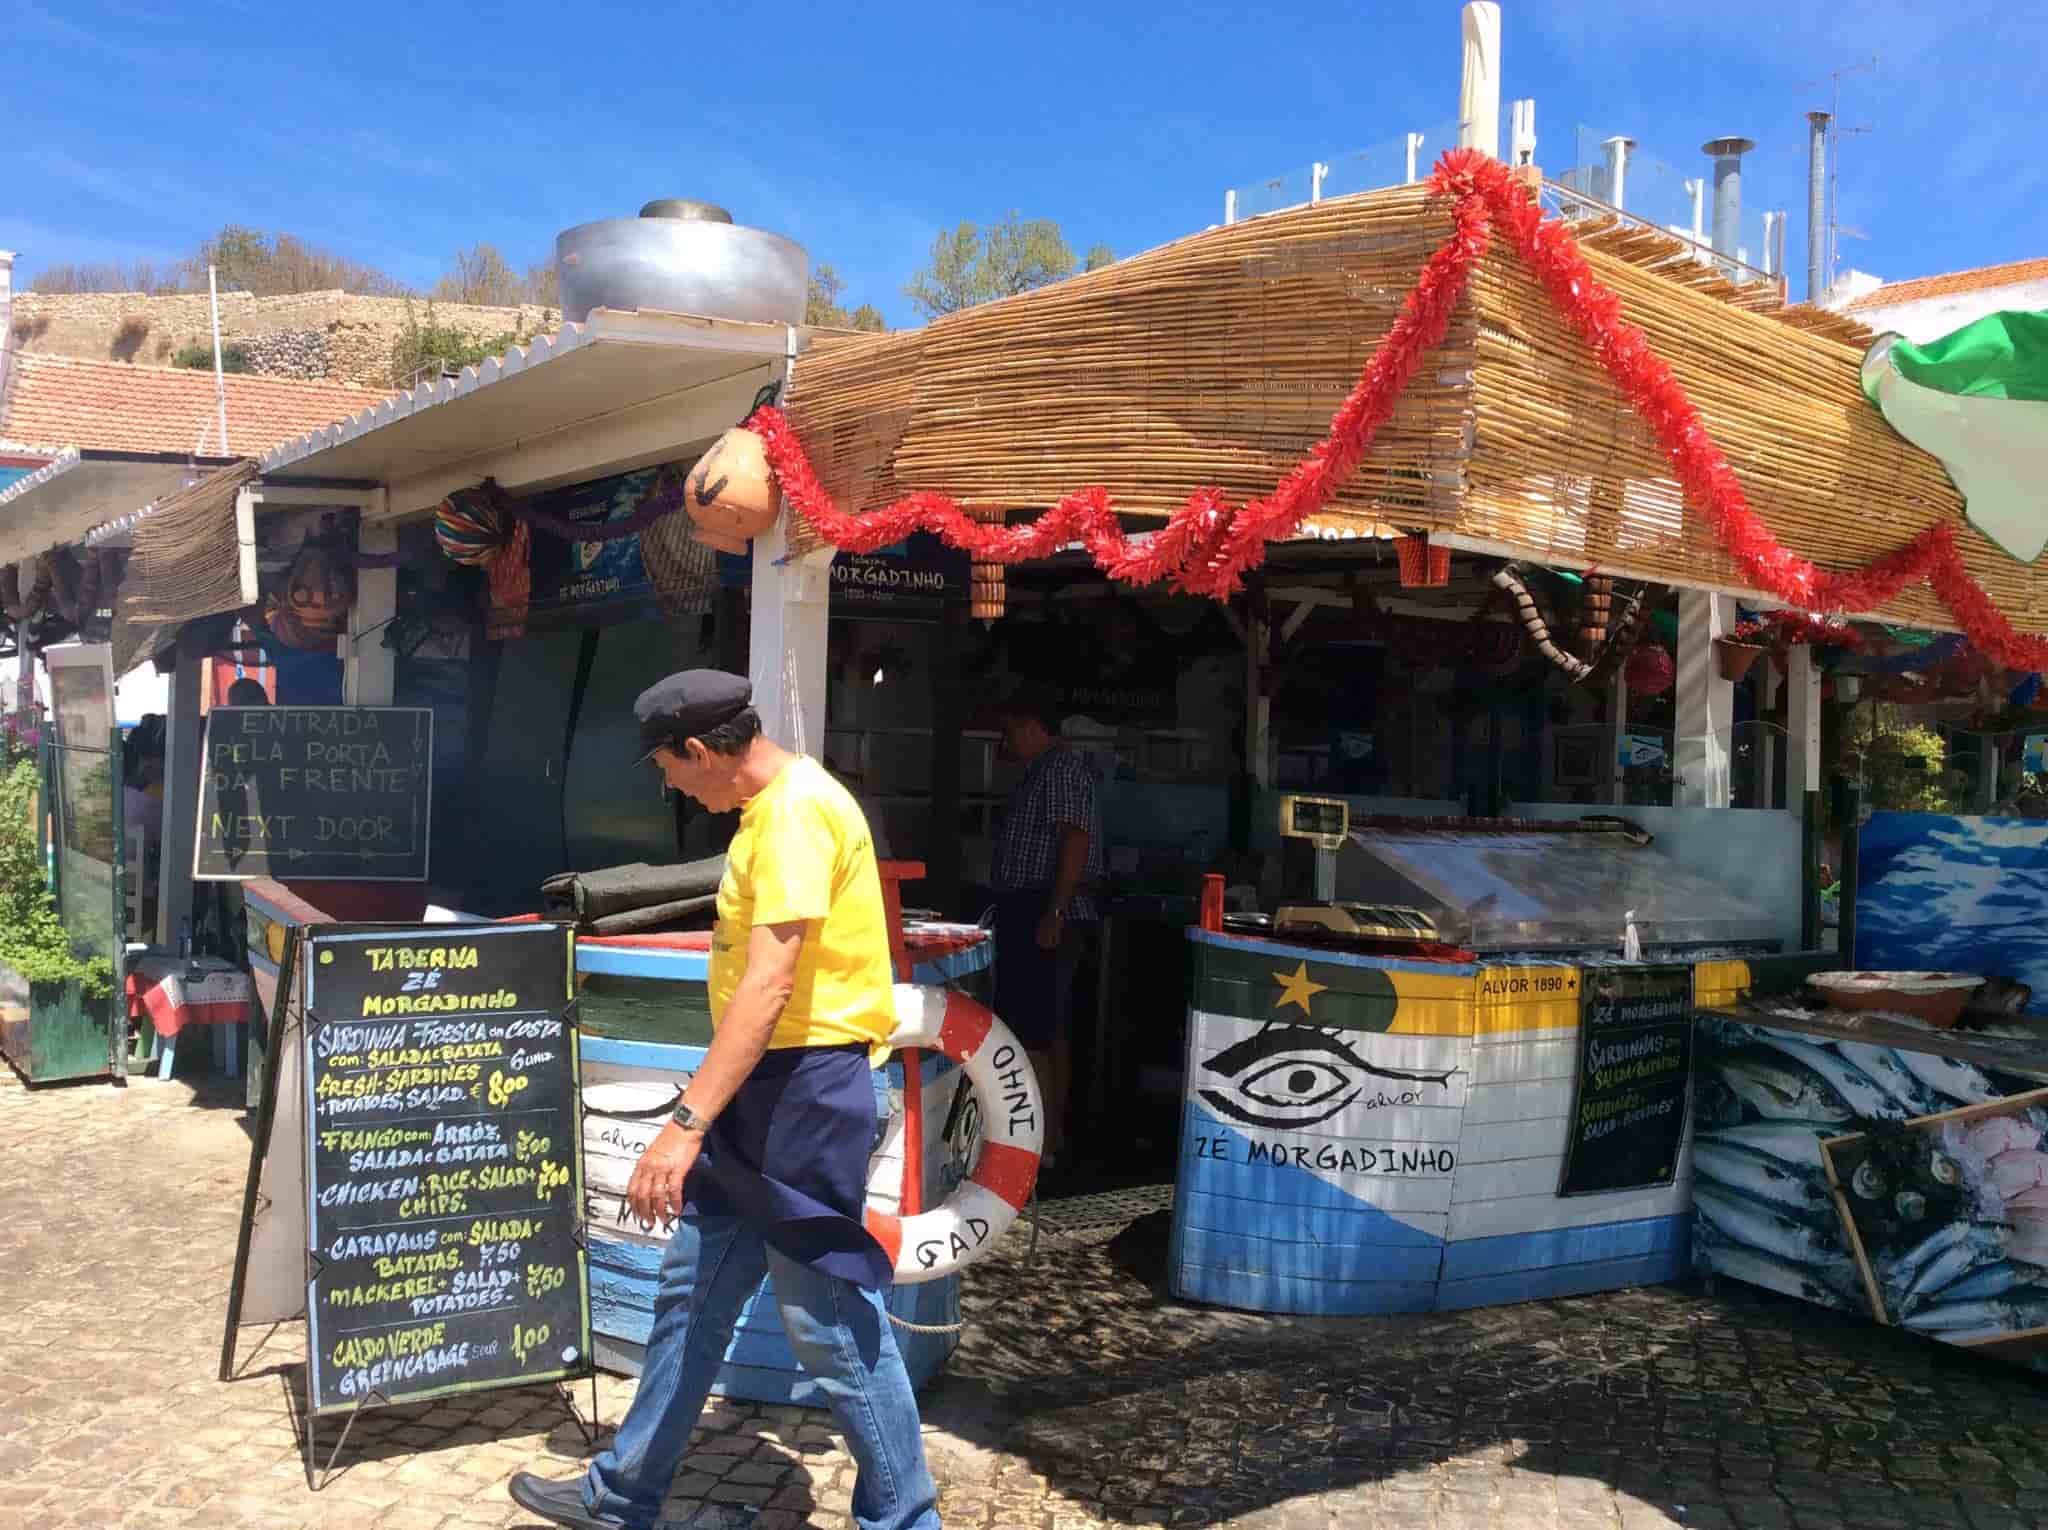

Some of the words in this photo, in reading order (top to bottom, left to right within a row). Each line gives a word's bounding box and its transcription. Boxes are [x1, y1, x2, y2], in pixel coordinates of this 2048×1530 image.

[242, 711, 379, 736] ENTRADA
[214, 738, 282, 764] PELA
[307, 741, 393, 766] PORTA
[280, 767, 409, 792] FRENTE
[211, 813, 295, 840] NEXT
[314, 816, 394, 841] DOOR
[365, 946, 479, 971] TABERNA
[401, 968, 442, 992] ZÉ
[1482, 978, 1529, 995] ALVOR
[1533, 977, 1563, 993] 1890
[362, 989, 518, 1016] MORGADINHO
[317, 1023, 406, 1057] SARDINHA
[503, 1020, 562, 1040] COSTA
[368, 1049, 432, 1069] SALADA
[441, 1042, 503, 1064] BATATA
[469, 1082, 483, 1099] €
[487, 1069, 529, 1110] 8,00
[1366, 1090, 1424, 1111] alvor
[320, 1128, 401, 1152] FRANGO
[600, 1128, 647, 1155] alvo
[1195, 1128, 1229, 1160] ZÉ
[1247, 1142, 1456, 1173] MORGADINHO
[349, 1151, 424, 1173] SALADA
[435, 1144, 510, 1163] BATATA
[320, 1176, 419, 1207] CHICKEN
[427, 1169, 472, 1195] RICE
[477, 1165, 528, 1191] SALAD
[399, 1193, 467, 1218] CHIPS.
[330, 1229, 438, 1260] CARAPAUS
[468, 1220, 532, 1246] SALADA
[915, 1218, 990, 1271] GAD
[373, 1248, 464, 1278] BATATAS.
[452, 1269, 513, 1295] SALAD
[332, 1336, 385, 1368] CALDO
[386, 1322, 446, 1358] VERDE
